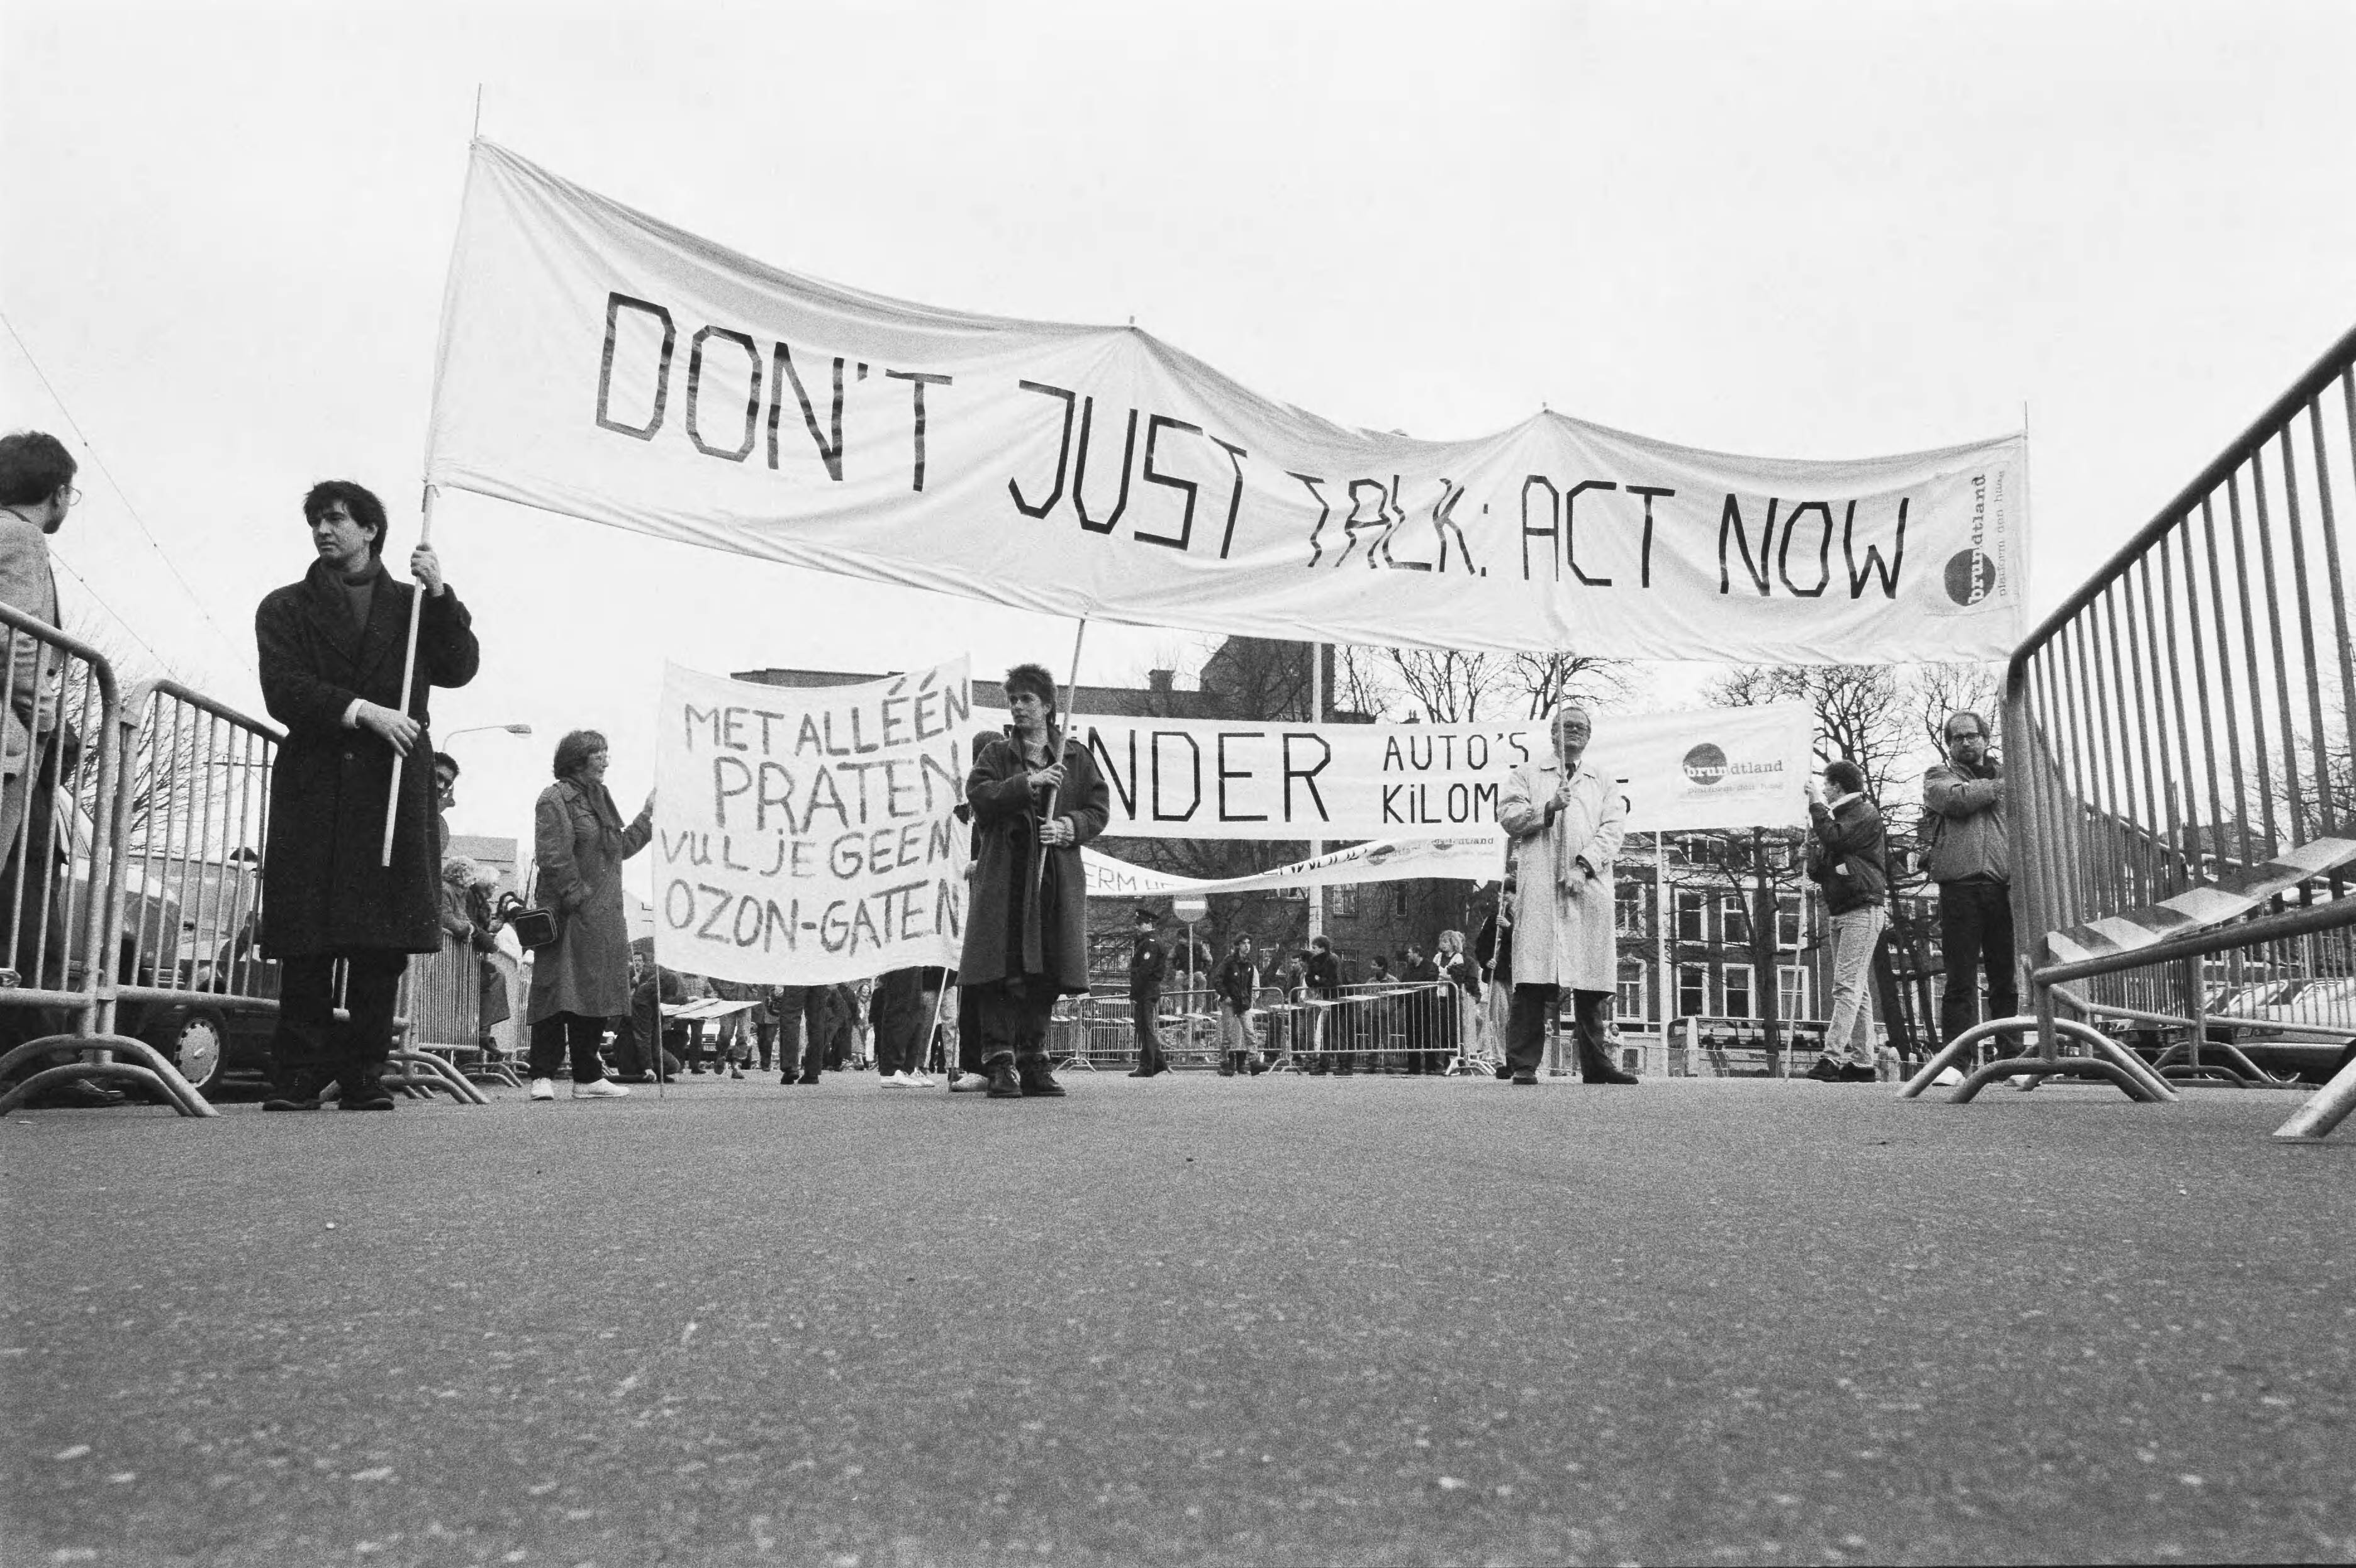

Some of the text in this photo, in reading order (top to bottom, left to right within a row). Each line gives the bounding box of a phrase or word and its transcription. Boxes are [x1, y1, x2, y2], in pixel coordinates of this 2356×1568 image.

[596, 292, 952, 492] DON'T
[1008, 380, 1248, 559] JUST
[1522, 475, 1675, 588] ACT
[1720, 493, 1909, 599] NOW
[1968, 474, 1985, 604] brundtland
[685, 703, 784, 755] MET
[1383, 732, 1529, 770] AUTO'S
[713, 739, 963, 835] PRATEN
[1003, 724, 1331, 823] NDER
[1685, 760, 1783, 777] brundtland
[829, 812, 952, 879] GEEN
[666, 879, 959, 956] OZON-GATEN
